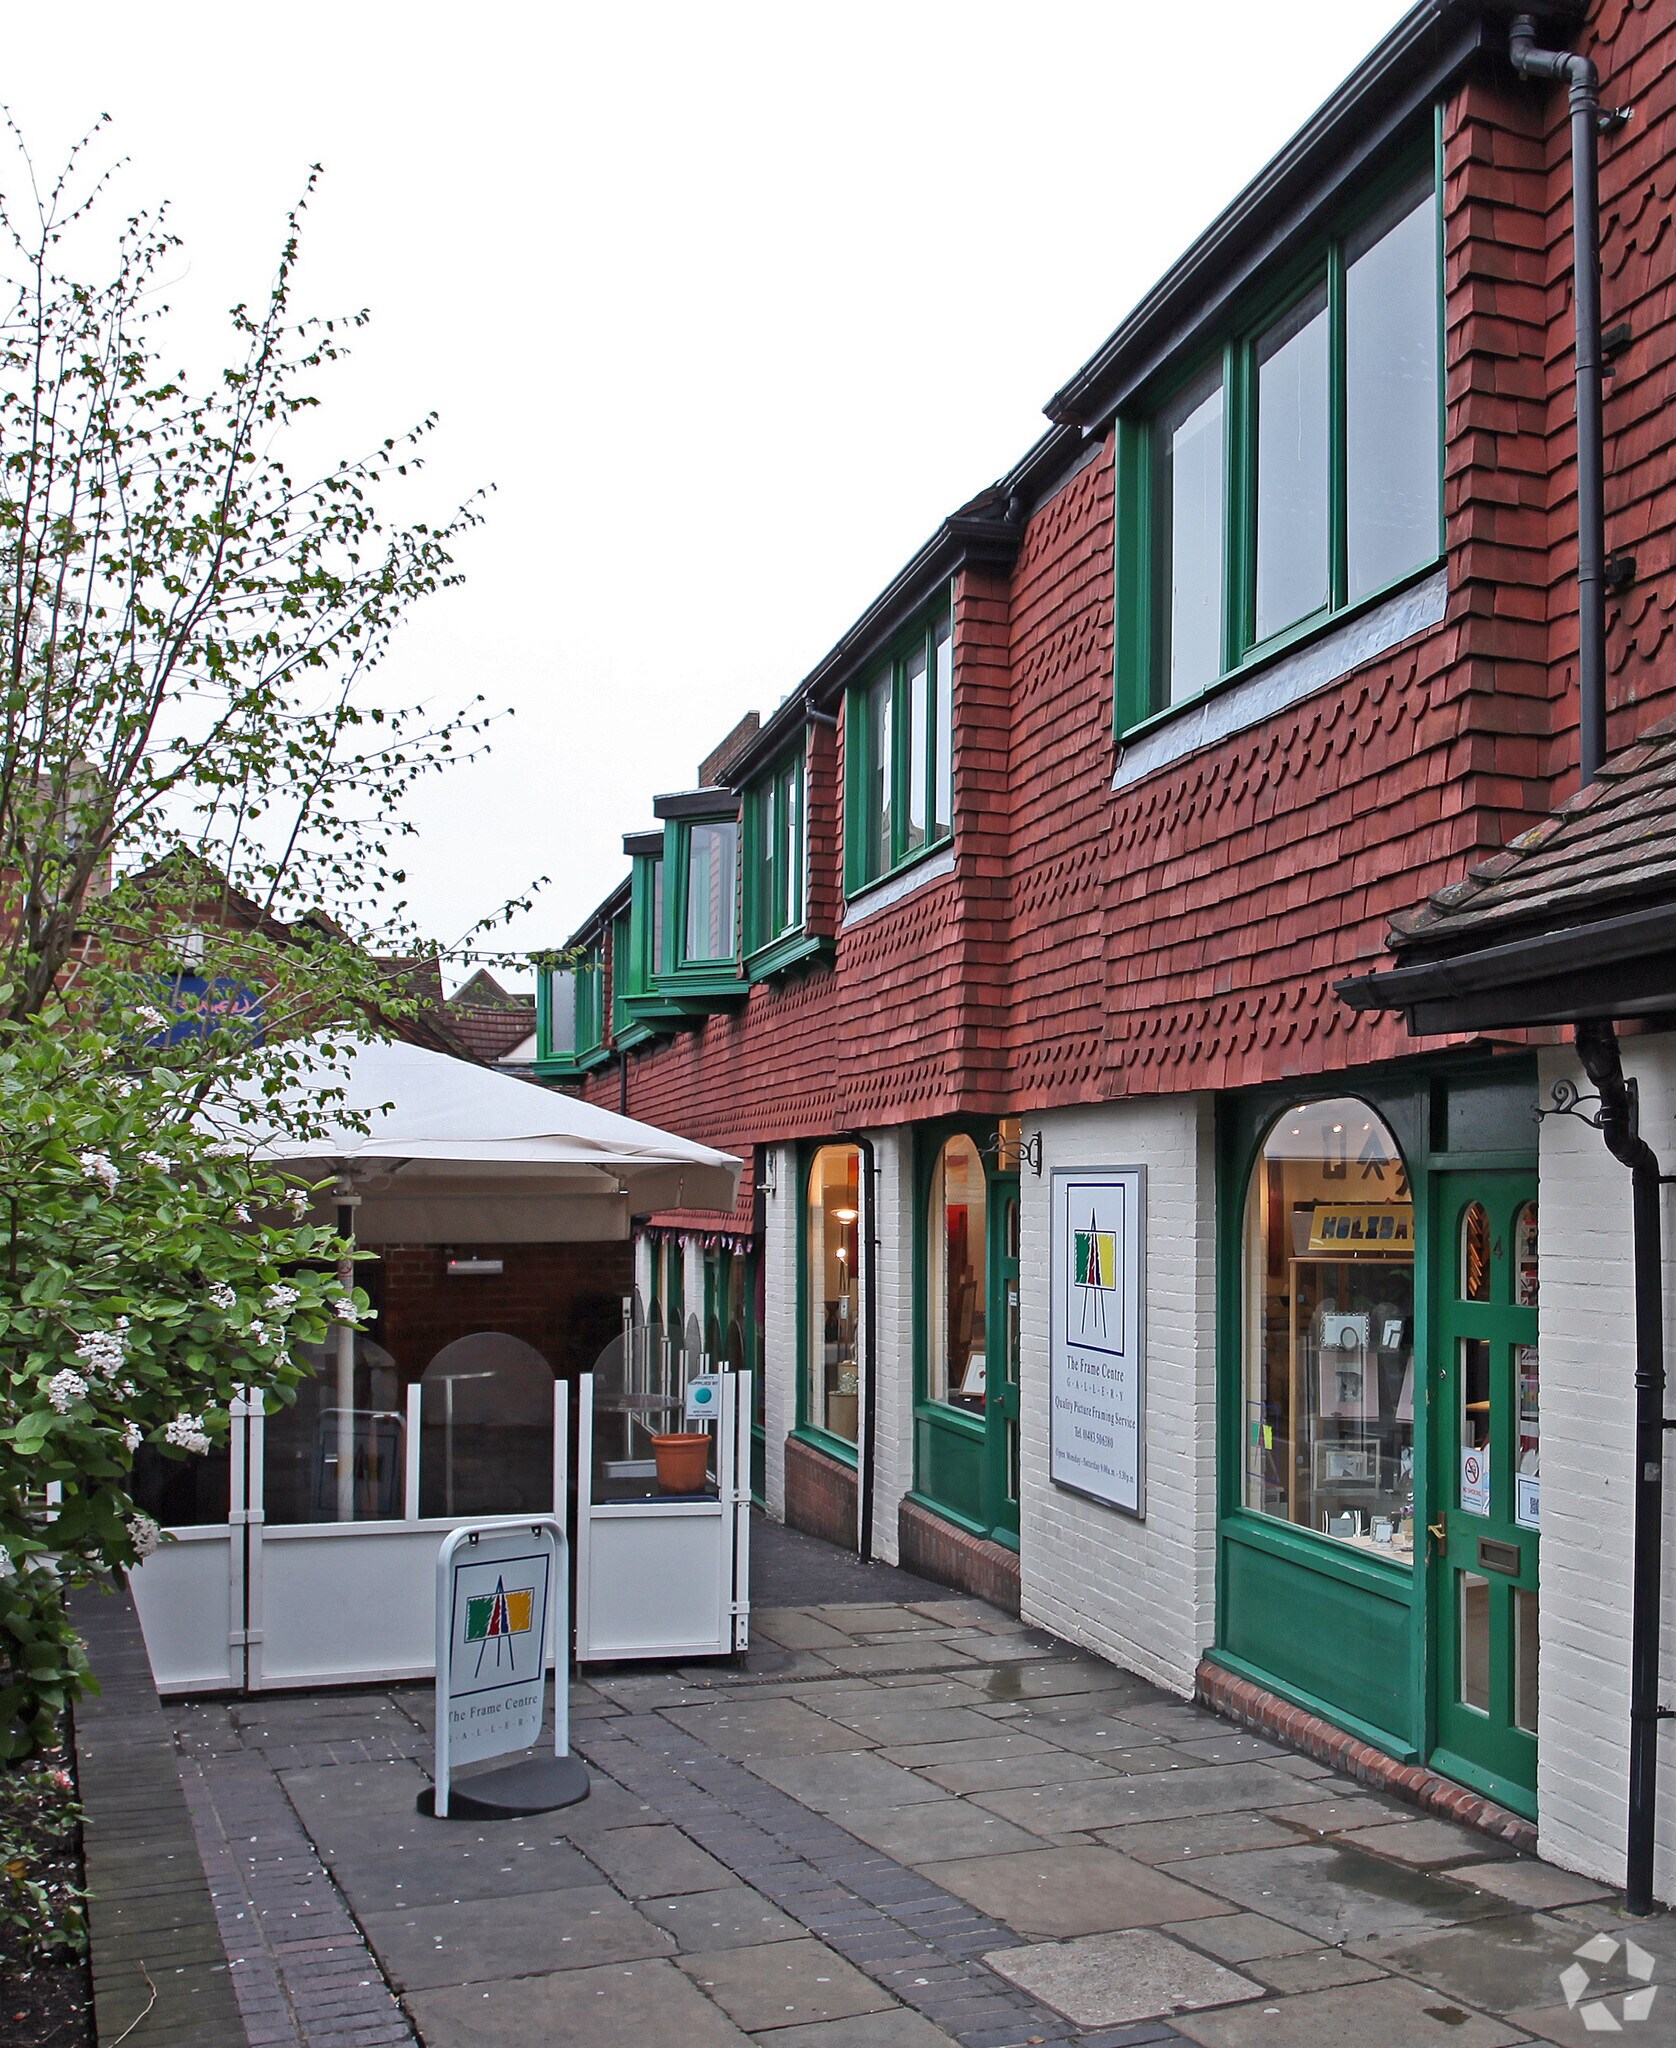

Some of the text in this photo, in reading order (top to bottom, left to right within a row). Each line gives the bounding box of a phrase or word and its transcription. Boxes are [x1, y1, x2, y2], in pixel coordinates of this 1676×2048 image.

[1321, 1215, 1415, 1240] HOLIDA
[1493, 1235, 1503, 1261] 4
[1067, 1355, 1124, 1382] The Frame Centre
[1055, 1395, 1136, 1429] Quality Picture Framing Service
[470, 1704, 502, 1719] Frame
[505, 1696, 538, 1711] Centre
